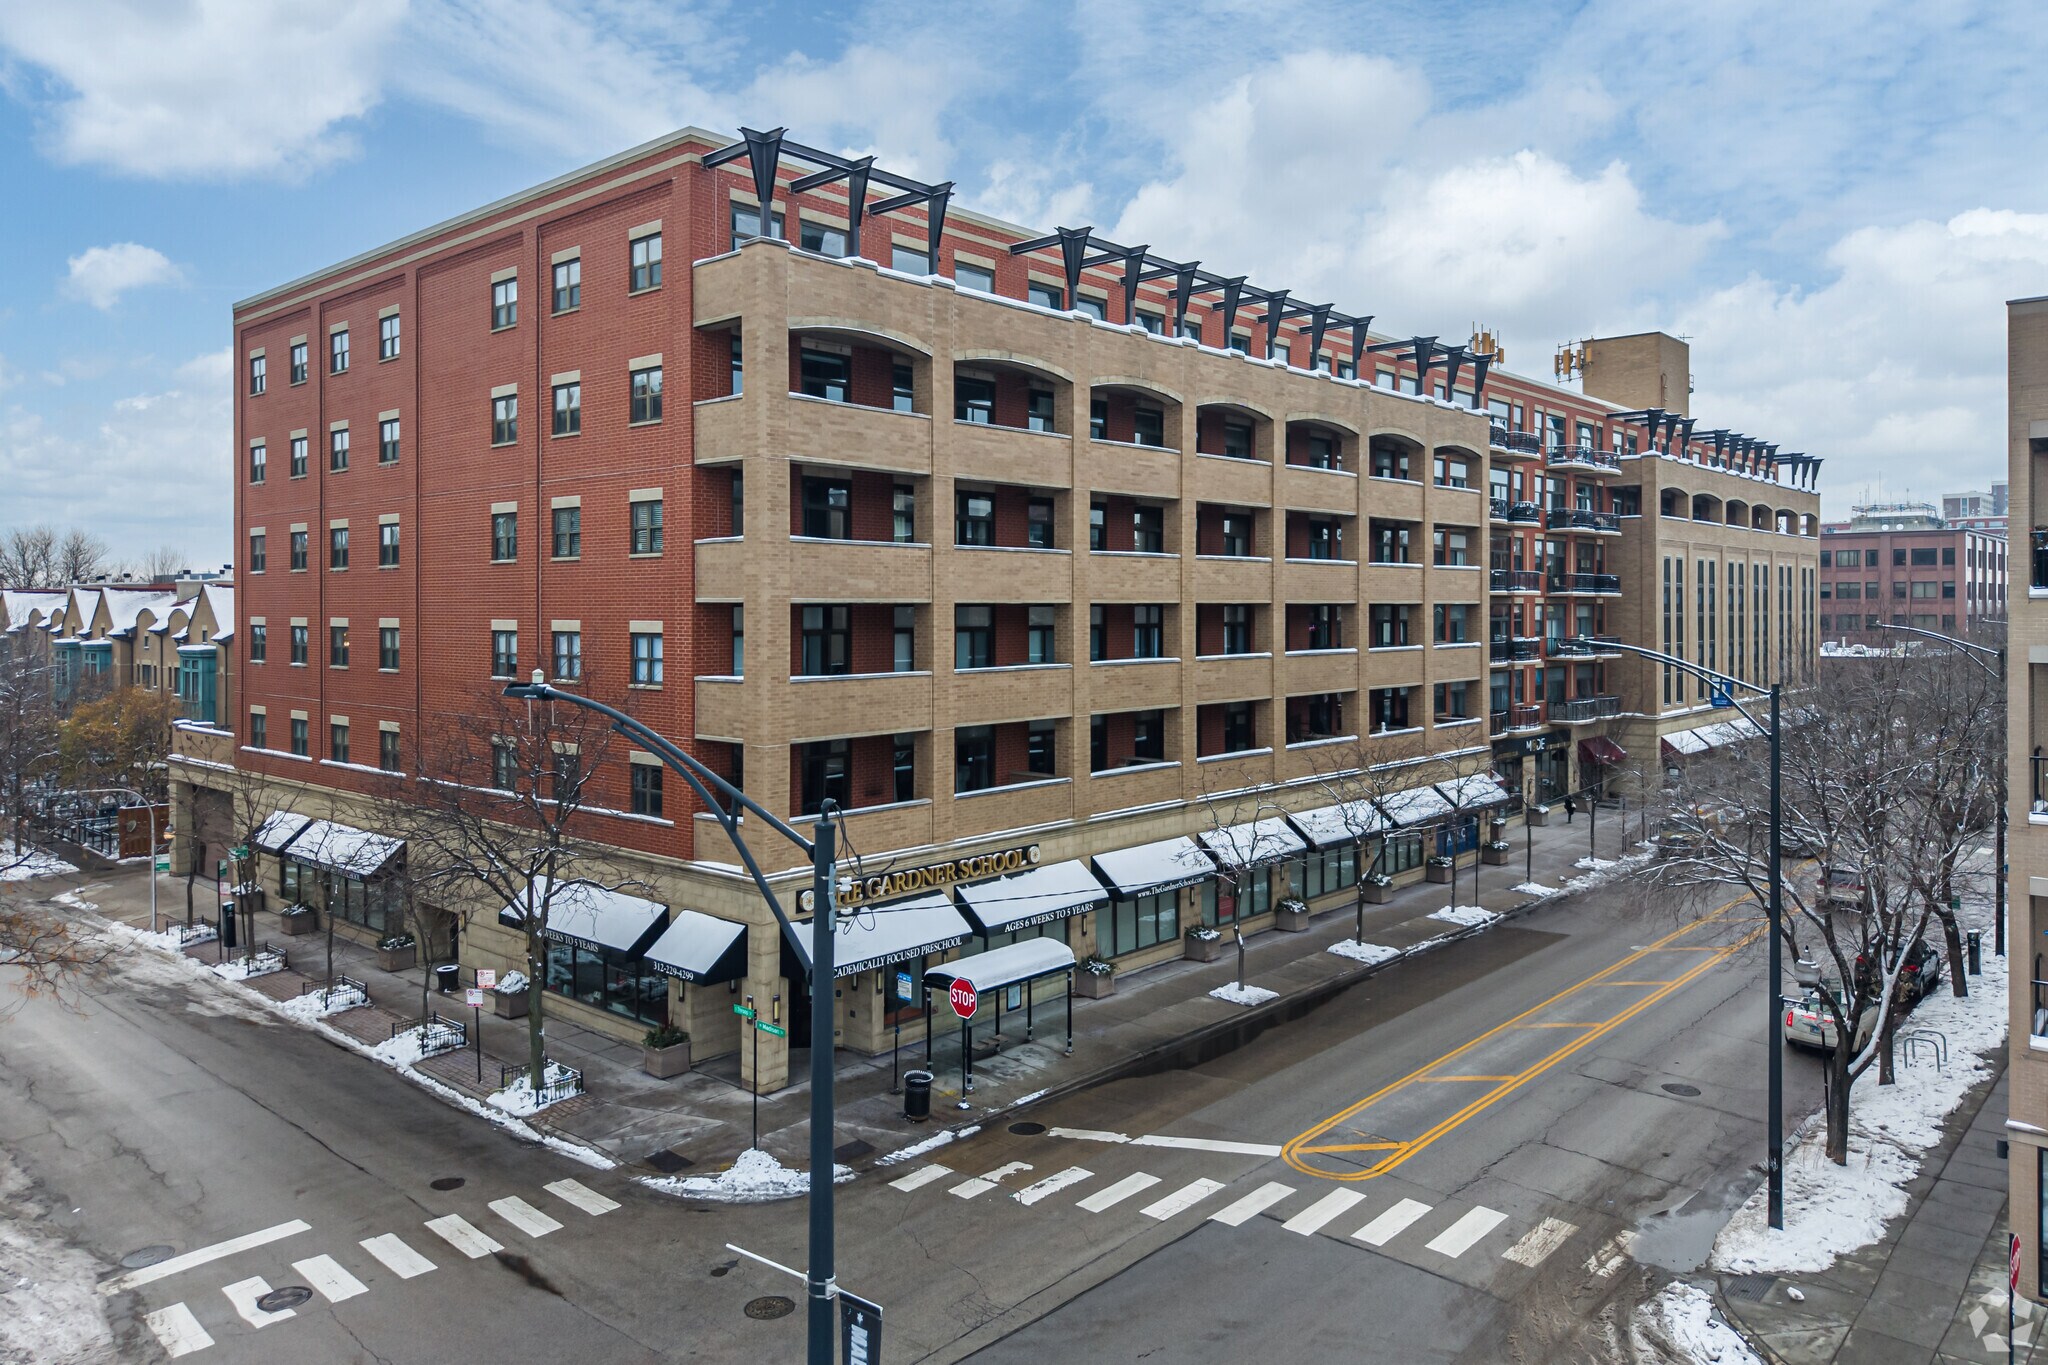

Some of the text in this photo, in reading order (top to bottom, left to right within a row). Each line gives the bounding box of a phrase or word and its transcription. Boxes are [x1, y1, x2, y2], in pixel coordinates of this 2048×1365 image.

[836, 848, 1027, 905] HE GARDNER SCHOOL
[1137, 876, 1205, 898] www.TheGardnerSchool.com
[1004, 901, 1094, 933] AGES 6 WEEKS TO 5 YEARS
[563, 934, 574, 945] TO
[573, 938, 578, 947] 5
[578, 938, 599, 953] YEARS
[833, 955, 886, 979] CADEMICALLY
[886, 946, 920, 965] FOCUSED
[920, 936, 963, 956] PRESCHOOL
[653, 960, 694, 981] 312-229-4299
[951, 987, 976, 1008] STOP
